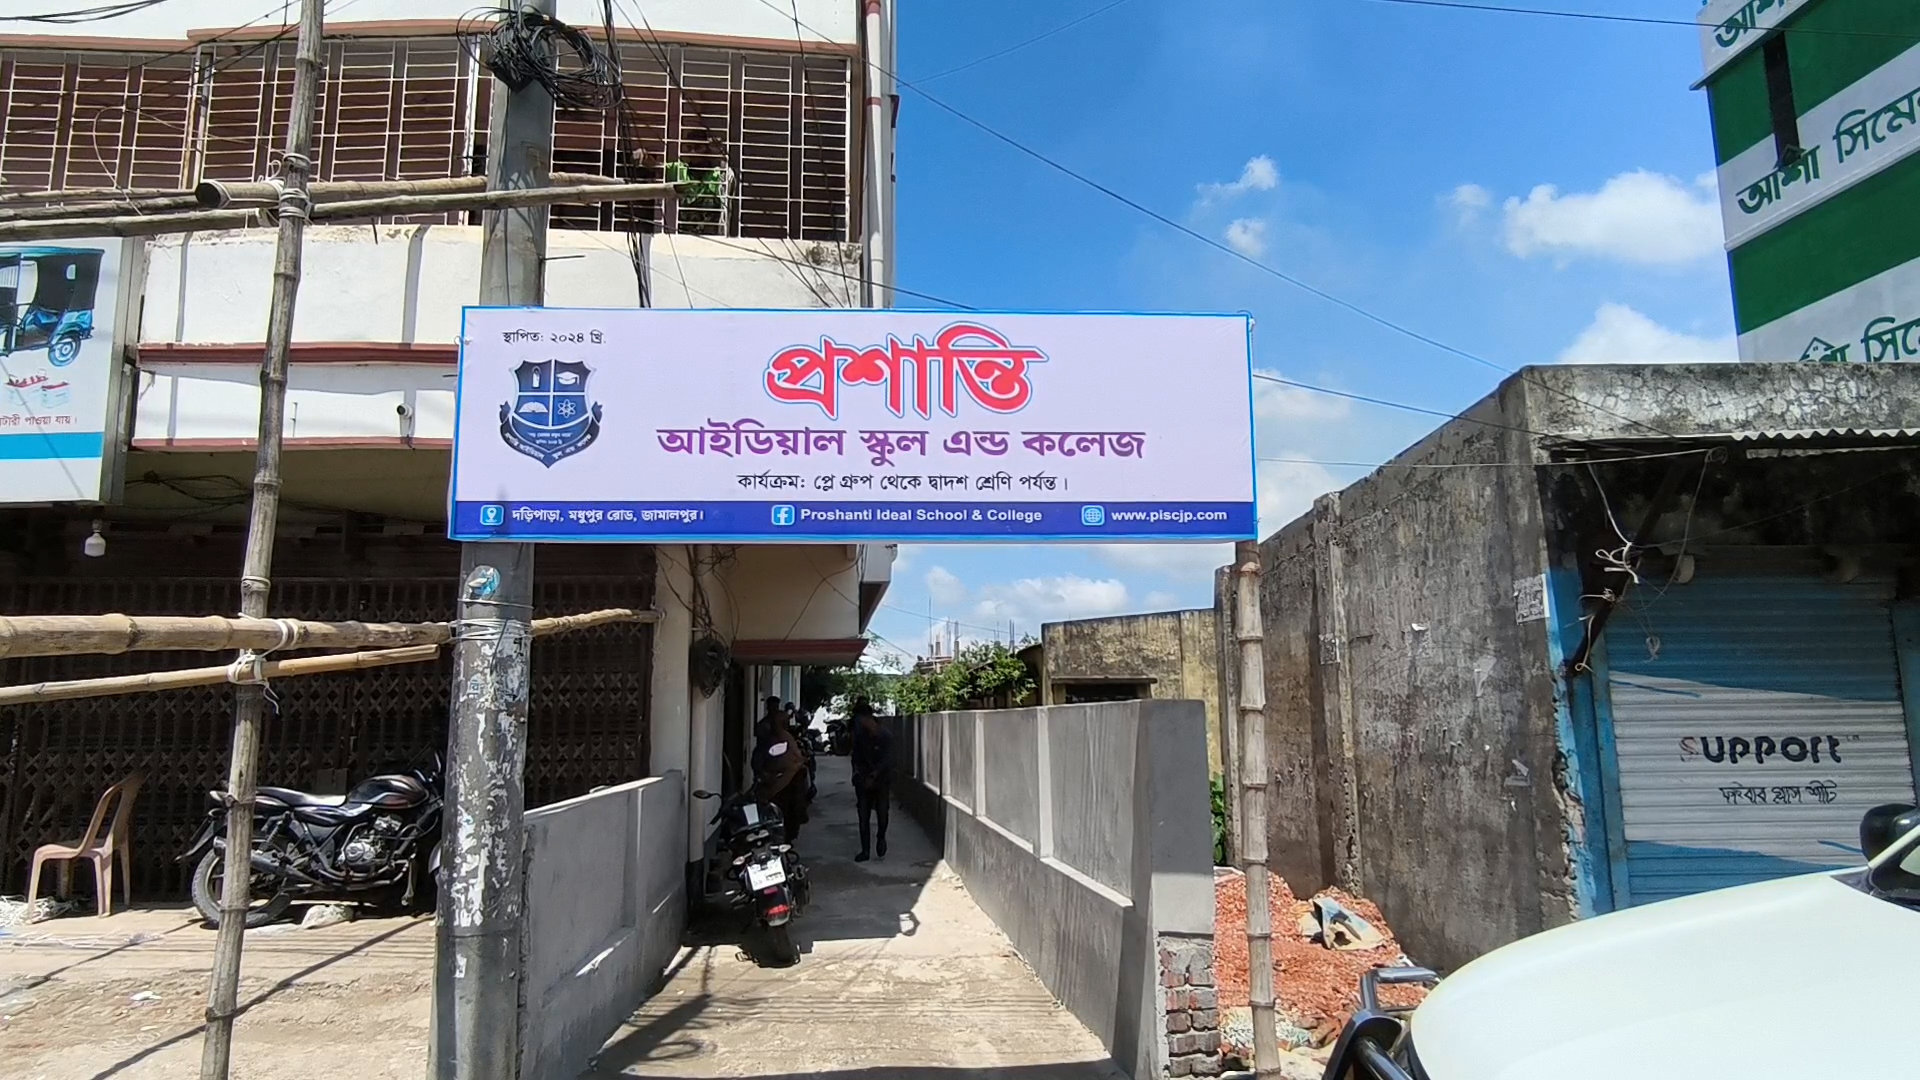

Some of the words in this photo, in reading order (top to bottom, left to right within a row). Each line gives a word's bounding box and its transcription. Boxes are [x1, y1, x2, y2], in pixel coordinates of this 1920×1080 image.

[1735, 145, 1821, 214] আশা
[1832, 86, 1920, 163] সিমে
[550, 332, 586, 345] ২০২৪
[763, 320, 1049, 420] প্রশান্তি
[657, 418, 846, 458] আইডিয়াল
[859, 429, 929, 467] স্কুল
[943, 430, 1010, 457] এন্ড
[1020, 431, 1146, 459] কলেজ
[814, 473, 836, 491] প্লে
[840, 474, 874, 490] গ্রুপ
[880, 473, 922, 490] থেকে
[928, 474, 969, 491] দ্বাদশ
[975, 471, 1013, 491] শ্রেণি
[512, 506, 564, 523] দড়িপাড়া,
[568, 509, 603, 523] মধুপুর
[607, 510, 637, 523] রোড,
[800, 508, 872, 521] Proshanti
[876, 508, 912, 521] Ideal
[916, 508, 967, 521] School
[971, 509, 983, 521] &
[987, 508, 1042, 523] College
[1111, 509, 1228, 523] www.piscjp.com
